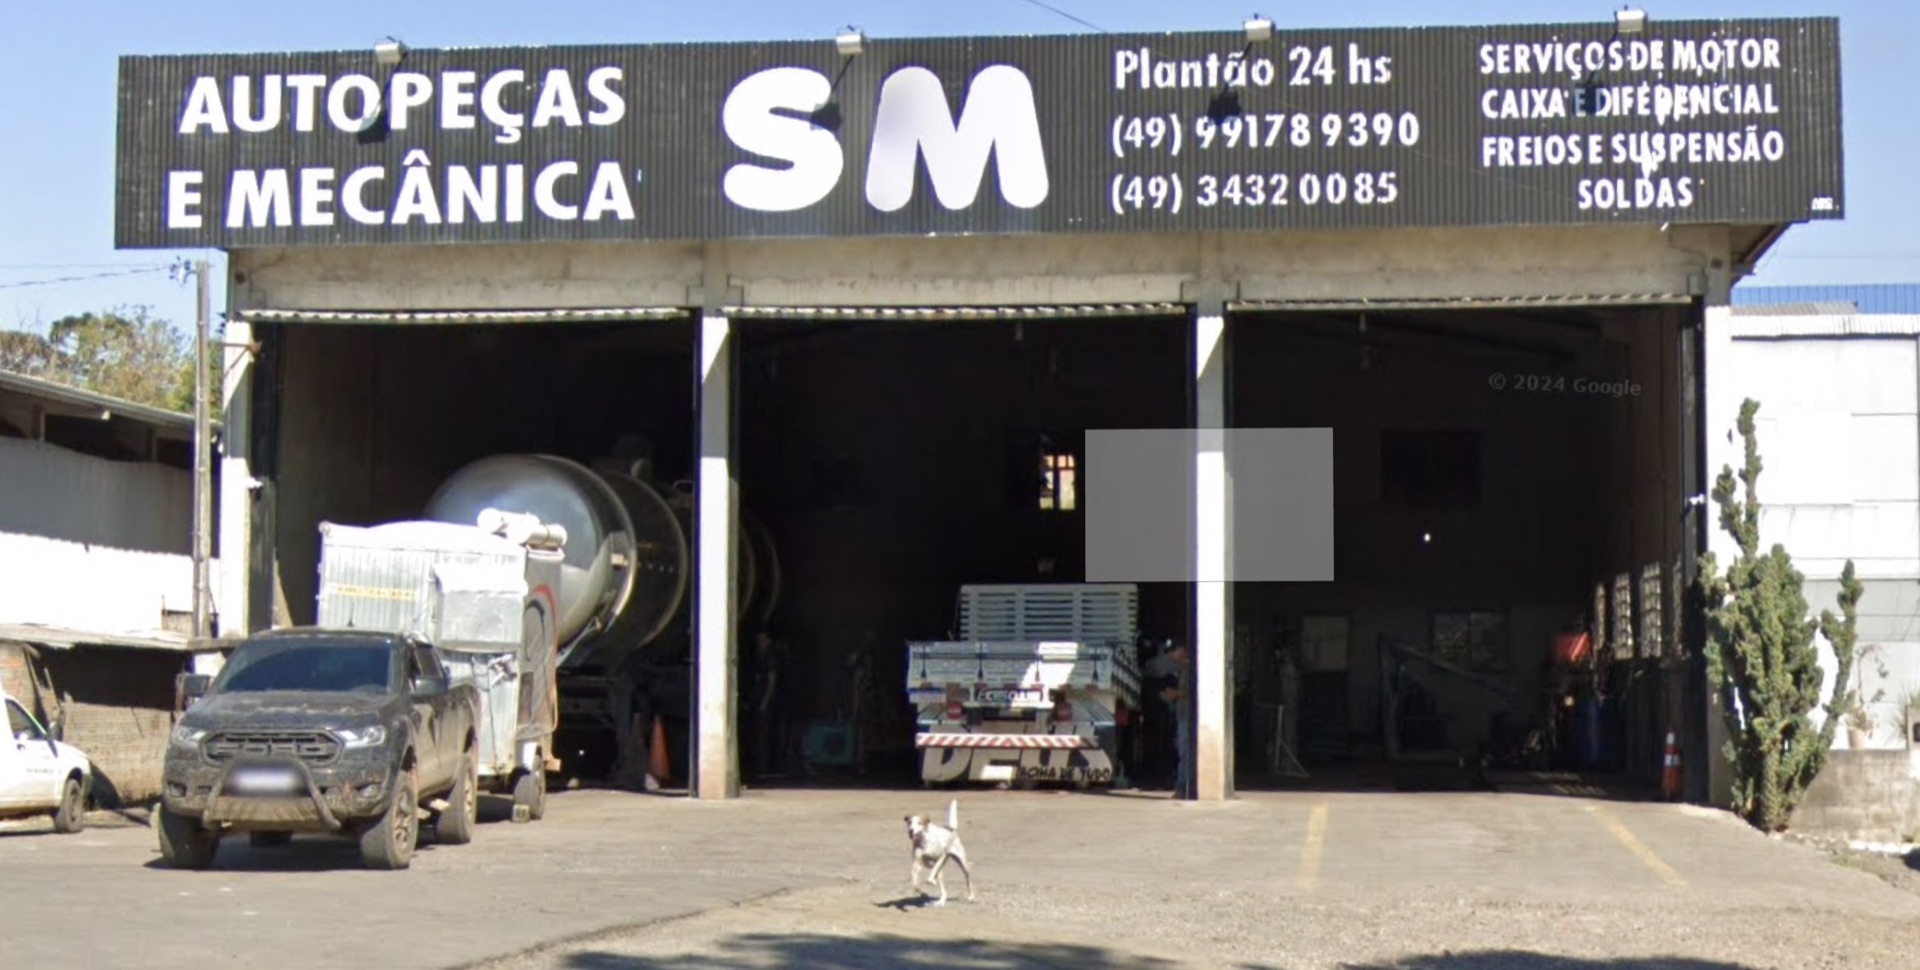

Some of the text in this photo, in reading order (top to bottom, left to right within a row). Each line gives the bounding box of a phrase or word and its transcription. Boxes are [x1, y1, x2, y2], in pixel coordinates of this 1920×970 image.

[1115, 43, 1392, 89] Plantão 24 hs
[1479, 39, 1781, 80] SERVIÇOS DE MOTOR
[179, 67, 626, 144] AUTOPEÇAS
[1481, 87, 1565, 119] CAIXA
[1575, 89, 1587, 118] E
[722, 64, 1049, 212] SM
[1112, 112, 1420, 157] (49) 99178 9390
[1482, 126, 1785, 167] FREIOS E SUSPENSÃO
[167, 149, 636, 229] E MECÂNICA
[1112, 172, 1398, 214] (49) 3432 0085
[1578, 177, 1694, 209] SOLDAS
